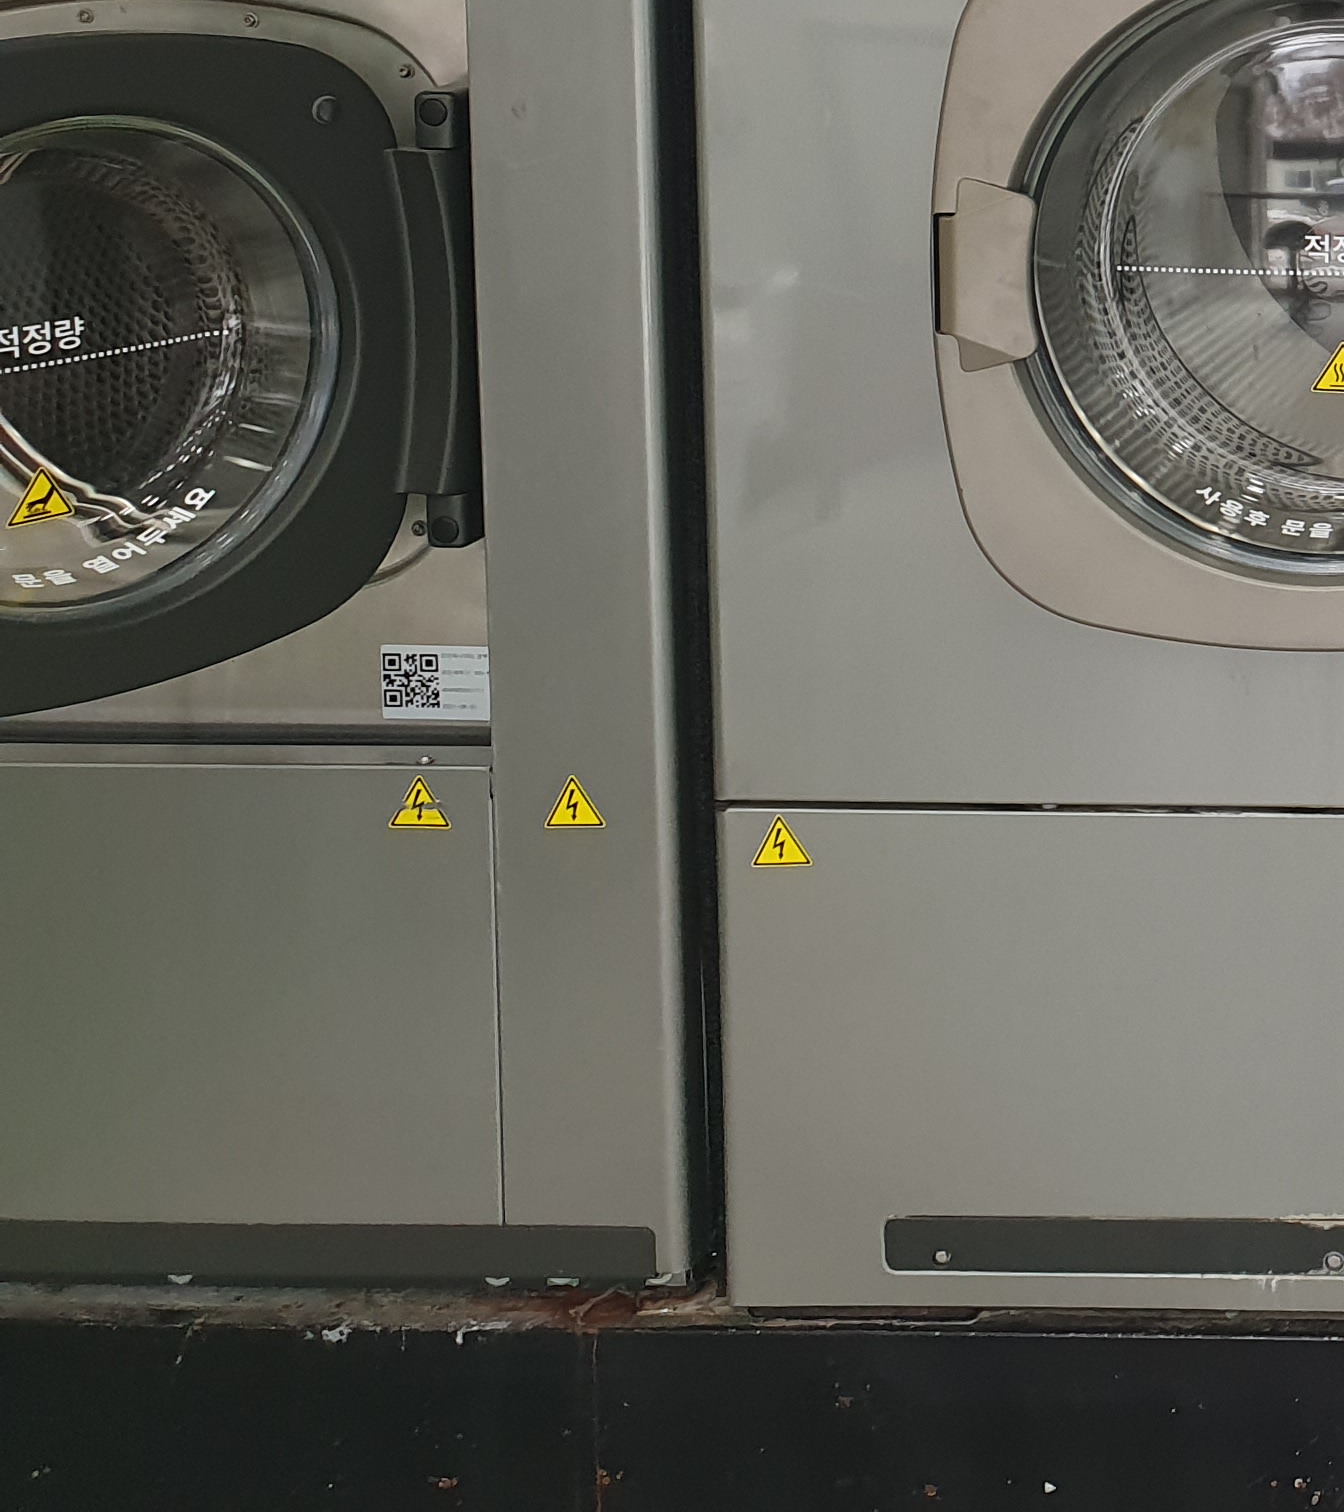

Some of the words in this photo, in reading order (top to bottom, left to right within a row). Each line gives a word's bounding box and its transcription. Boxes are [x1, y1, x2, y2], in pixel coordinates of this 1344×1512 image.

[0, 317, 84, 358] 적정량
[1196, 487, 1270, 528] 사용후
[1281, 519, 1333, 539] 문을
